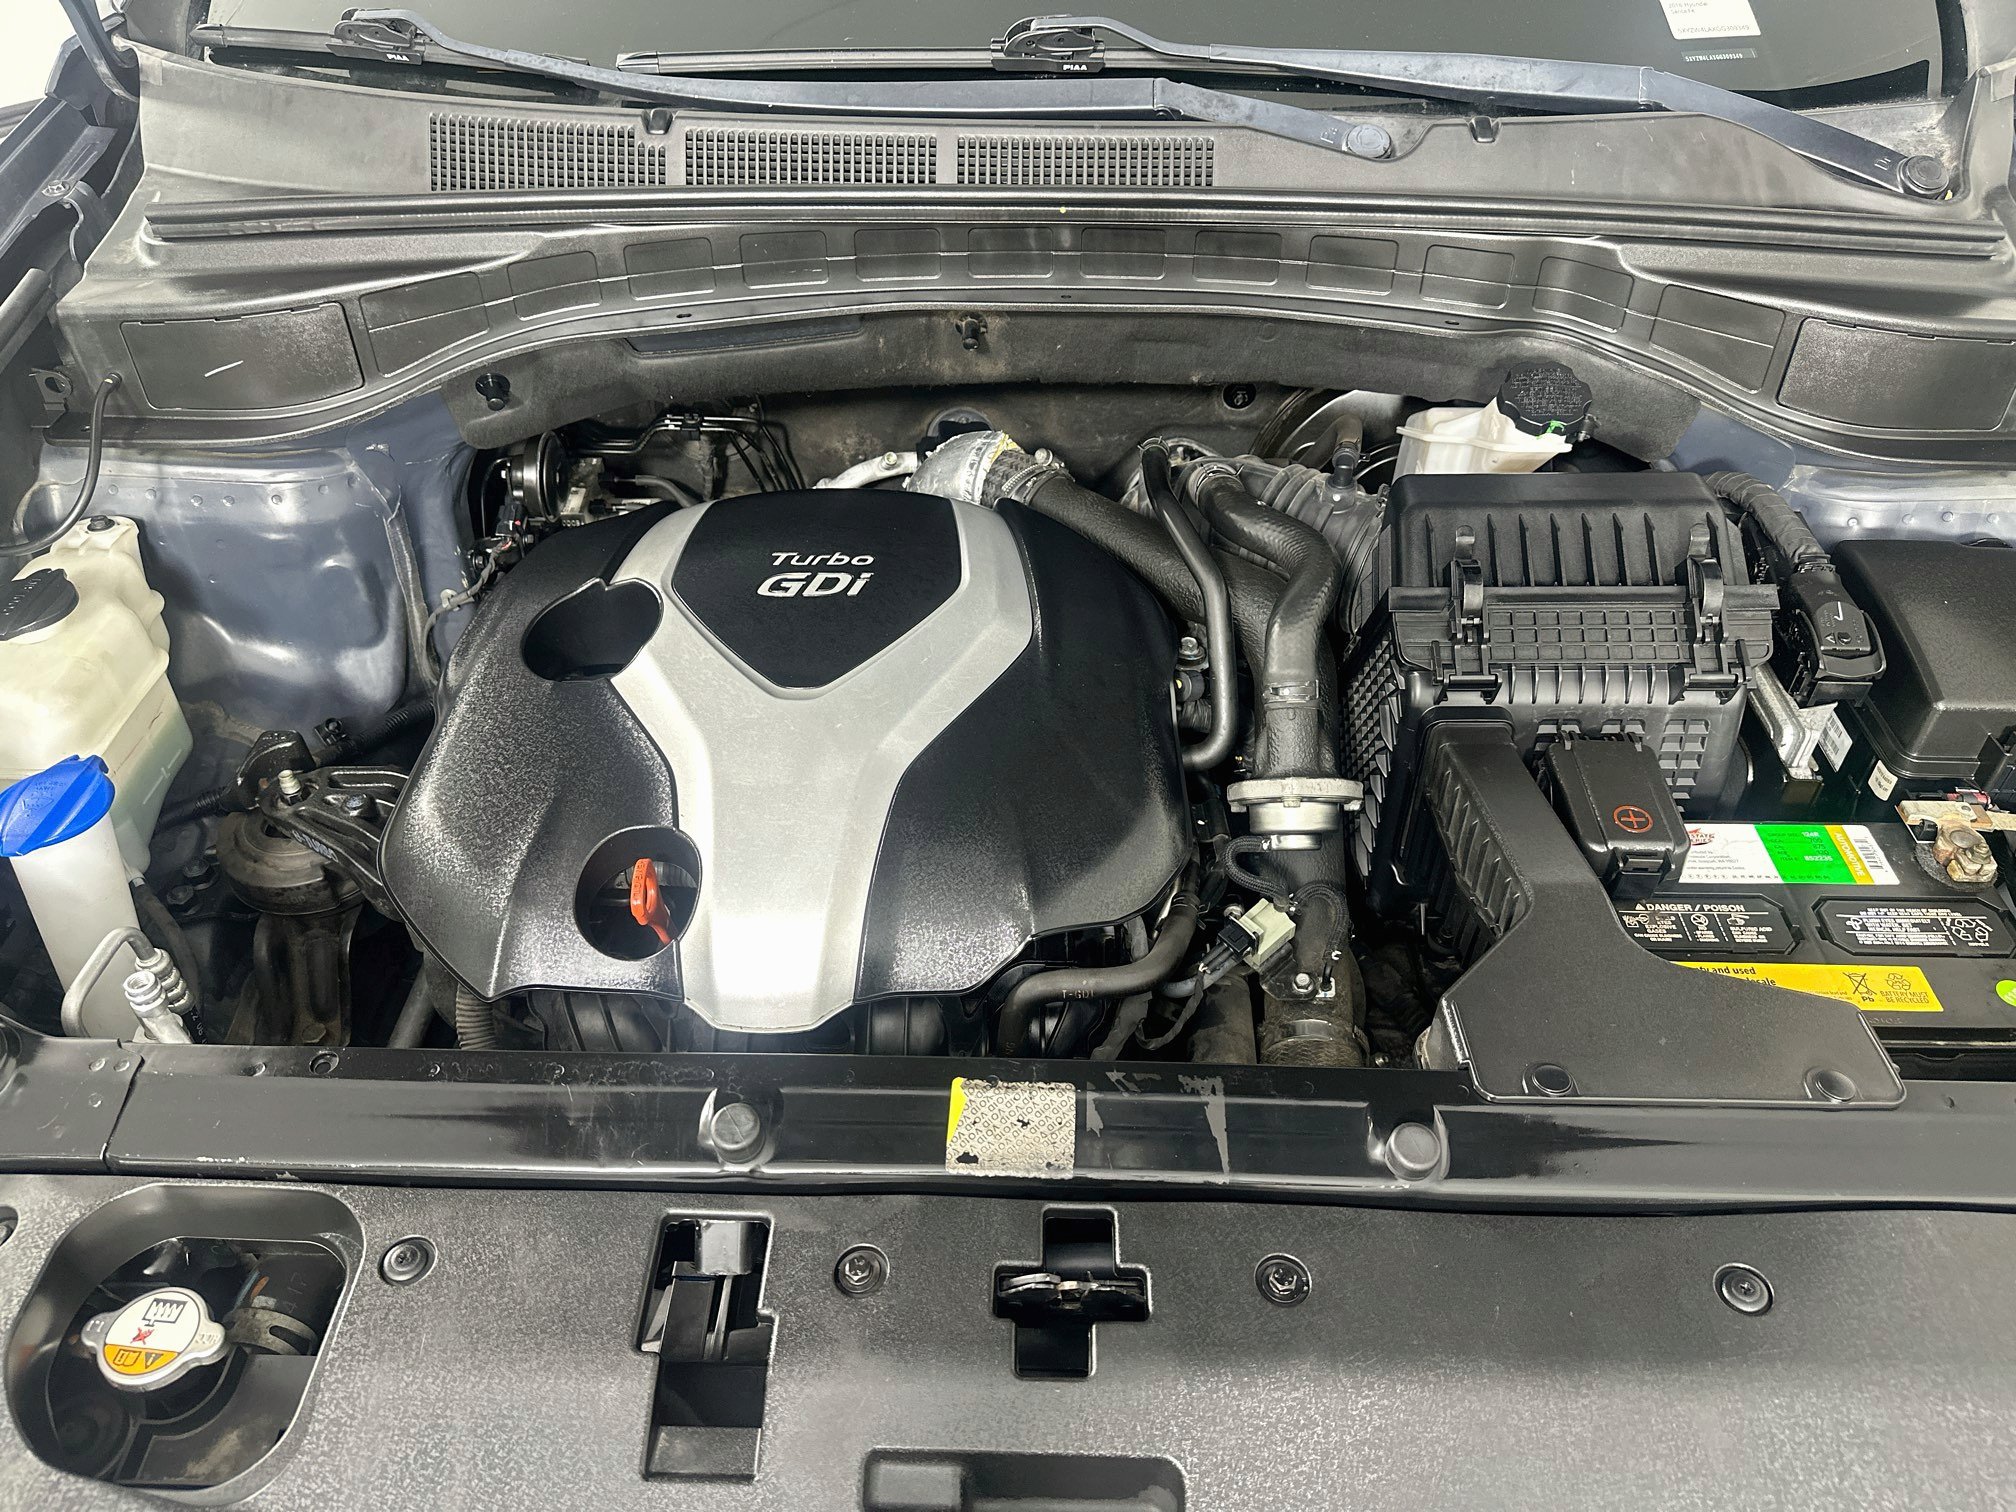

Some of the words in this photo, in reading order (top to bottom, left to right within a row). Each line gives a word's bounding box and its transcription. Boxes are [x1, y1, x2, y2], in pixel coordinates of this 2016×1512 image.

[386, 53, 410, 62] PIAA
[771, 551, 875, 566] Turbo
[757, 572, 875, 598] GDi
[1834, 832, 1865, 877] AUTOMOTIVE
[1703, 904, 1745, 912] POISON
[1712, 966, 1729, 974] and
[1732, 966, 1756, 975] used
[987, 1090, 1010, 1112] VOID
[1034, 1099, 1056, 1118] VOID
[1051, 1096, 1073, 1115] VOID
[982, 1108, 1005, 1128] VOID
[999, 1105, 1023, 1124] VOID
[1017, 1101, 1039, 1122] VOID
[1029, 1115, 1052, 1134] VOID
[1047, 1112, 1069, 1131] VOID
[959, 1128, 983, 1148] VOID
[977, 1124, 1000, 1144] VOID
[994, 1122, 1017, 1141] VOID
[1007, 1134, 1030, 1154] VOID
